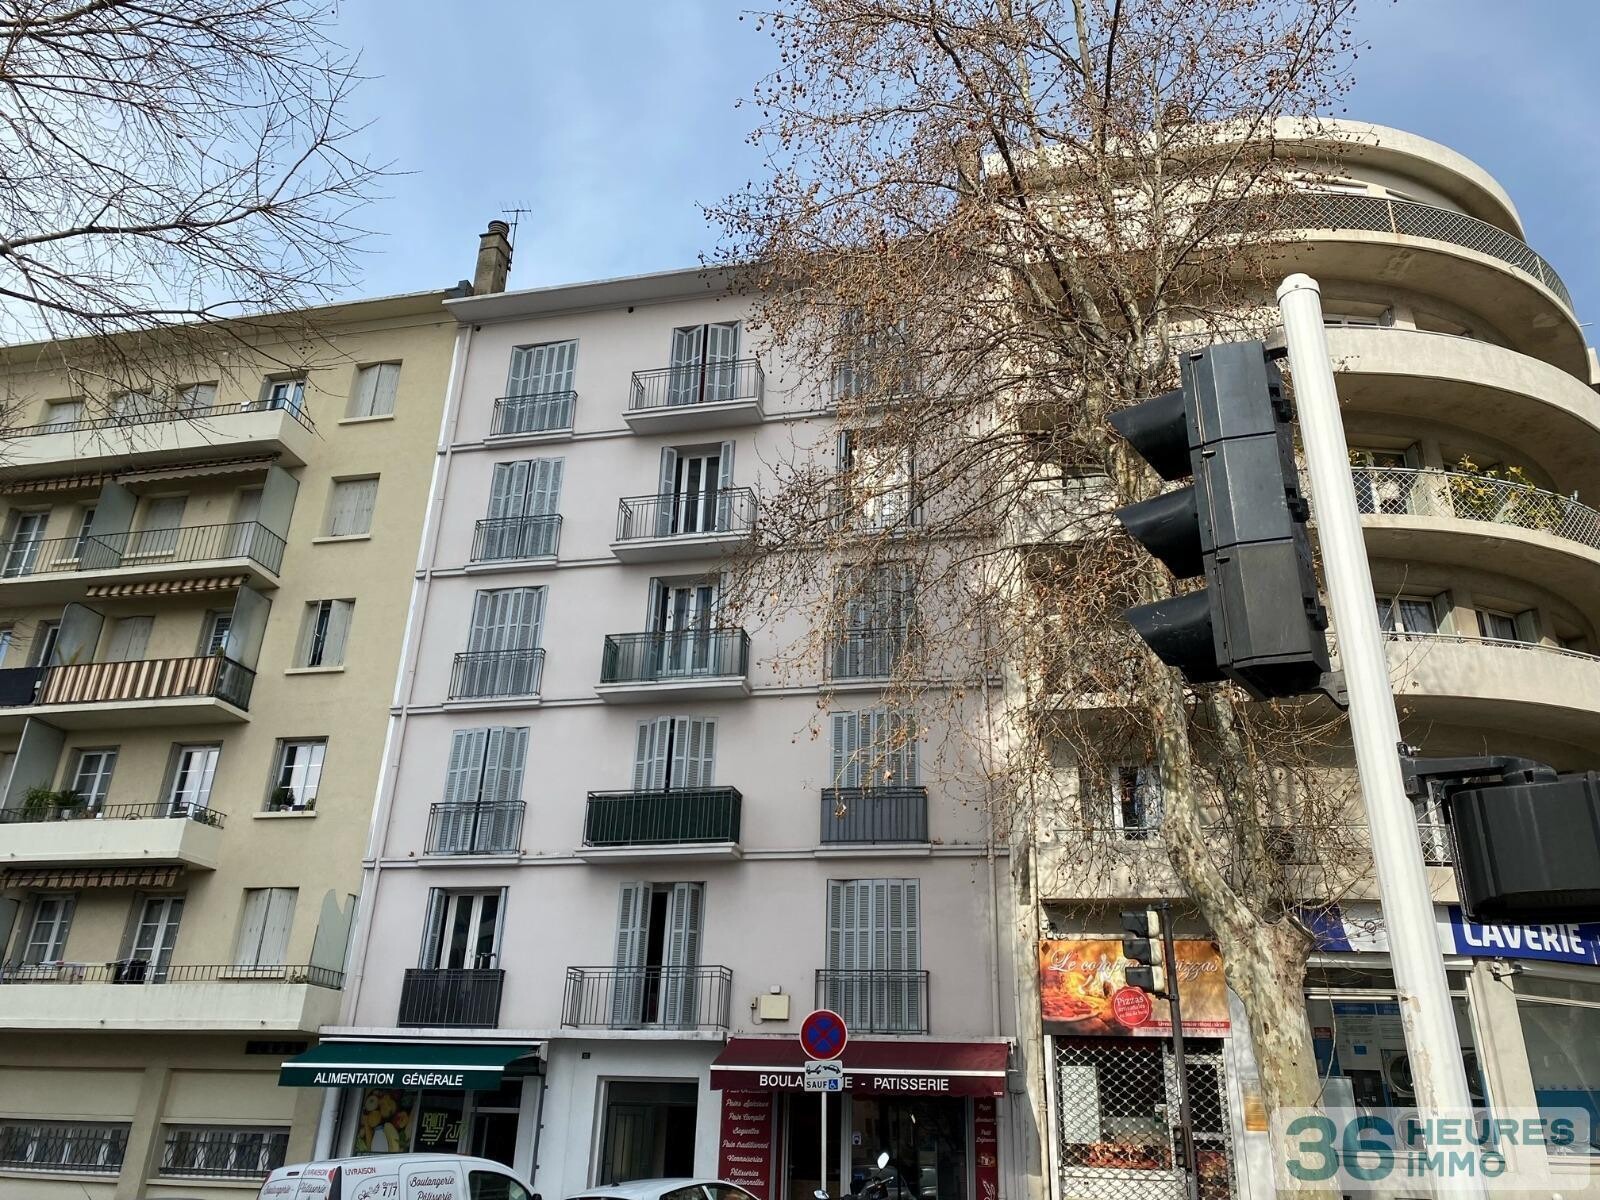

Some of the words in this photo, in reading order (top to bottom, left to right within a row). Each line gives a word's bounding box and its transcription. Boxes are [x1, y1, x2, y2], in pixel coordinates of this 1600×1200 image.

[1462, 922, 1586, 955] LAVERIE
[1047, 949, 1078, 973] Le
[1175, 959, 1218, 981] izzas
[1116, 996, 1144, 1006] Pizzas
[314, 1072, 394, 1085] ALIMENTATION
[402, 1072, 463, 1086] GÉNÉRALE
[759, 1074, 853, 1089] BOULAIE
[874, 1077, 949, 1091] PATISSERIE
[806, 1080, 828, 1089] SAUF
[344, 1166, 376, 1176] LIVRAISON
[409, 1175, 455, 1189] Boulangerie
[382, 1186, 398, 1198] 7/7
